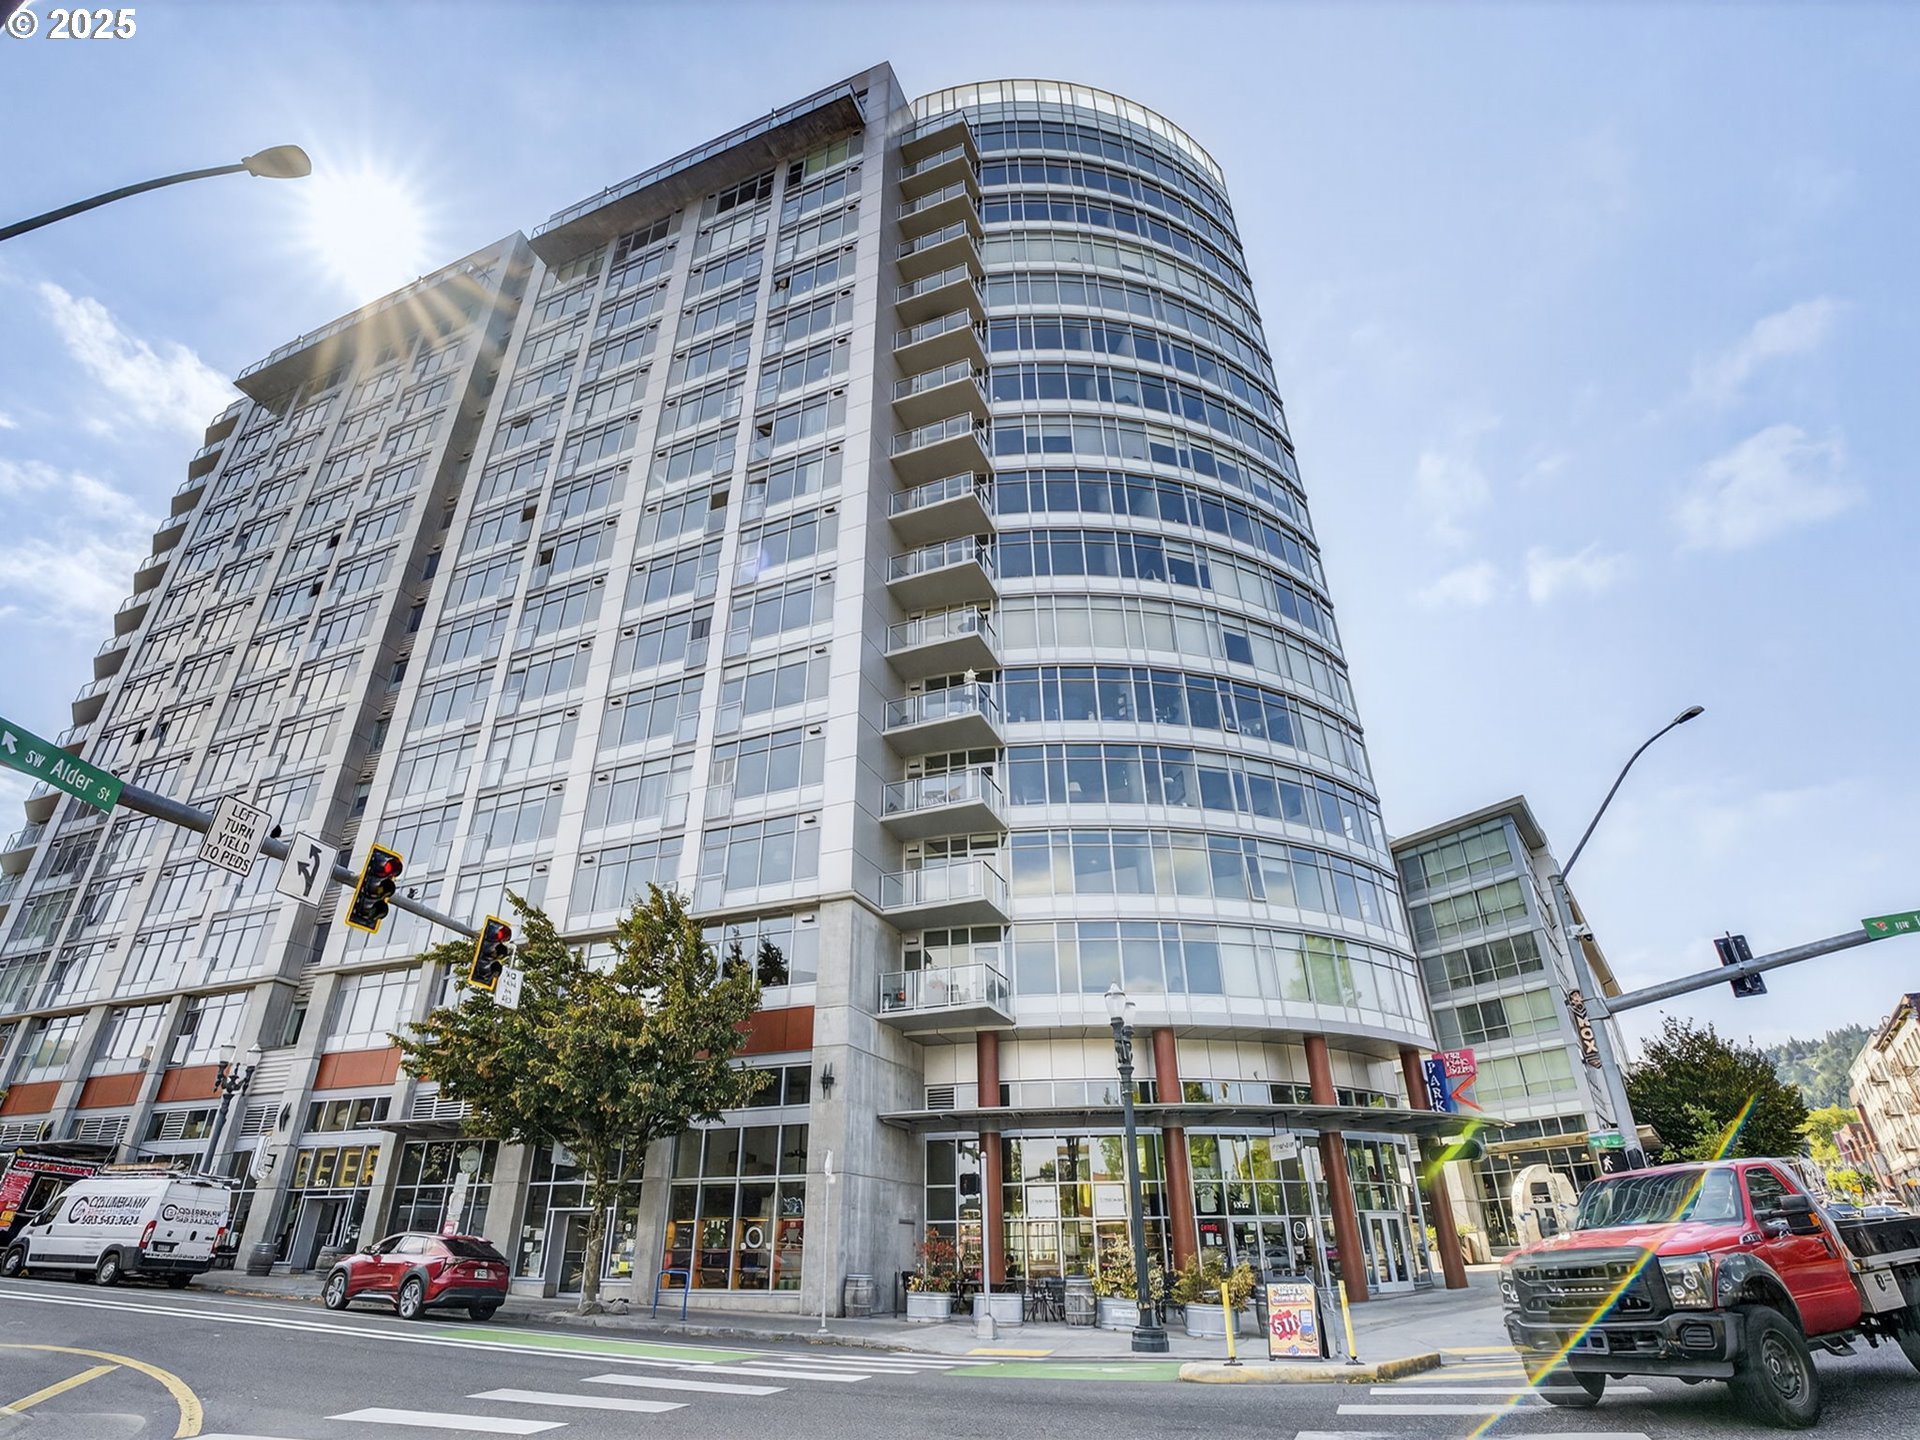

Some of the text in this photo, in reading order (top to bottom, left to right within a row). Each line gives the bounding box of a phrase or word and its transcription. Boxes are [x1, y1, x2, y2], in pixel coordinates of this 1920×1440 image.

[25, 750, 110, 802] SW Alder St
[232, 804, 259, 825] LEFT
[225, 817, 255, 840] TURN
[218, 832, 250, 855] YIELD
[204, 843, 250, 872] TO PEDS
[1427, 1061, 1446, 1113] PARK
